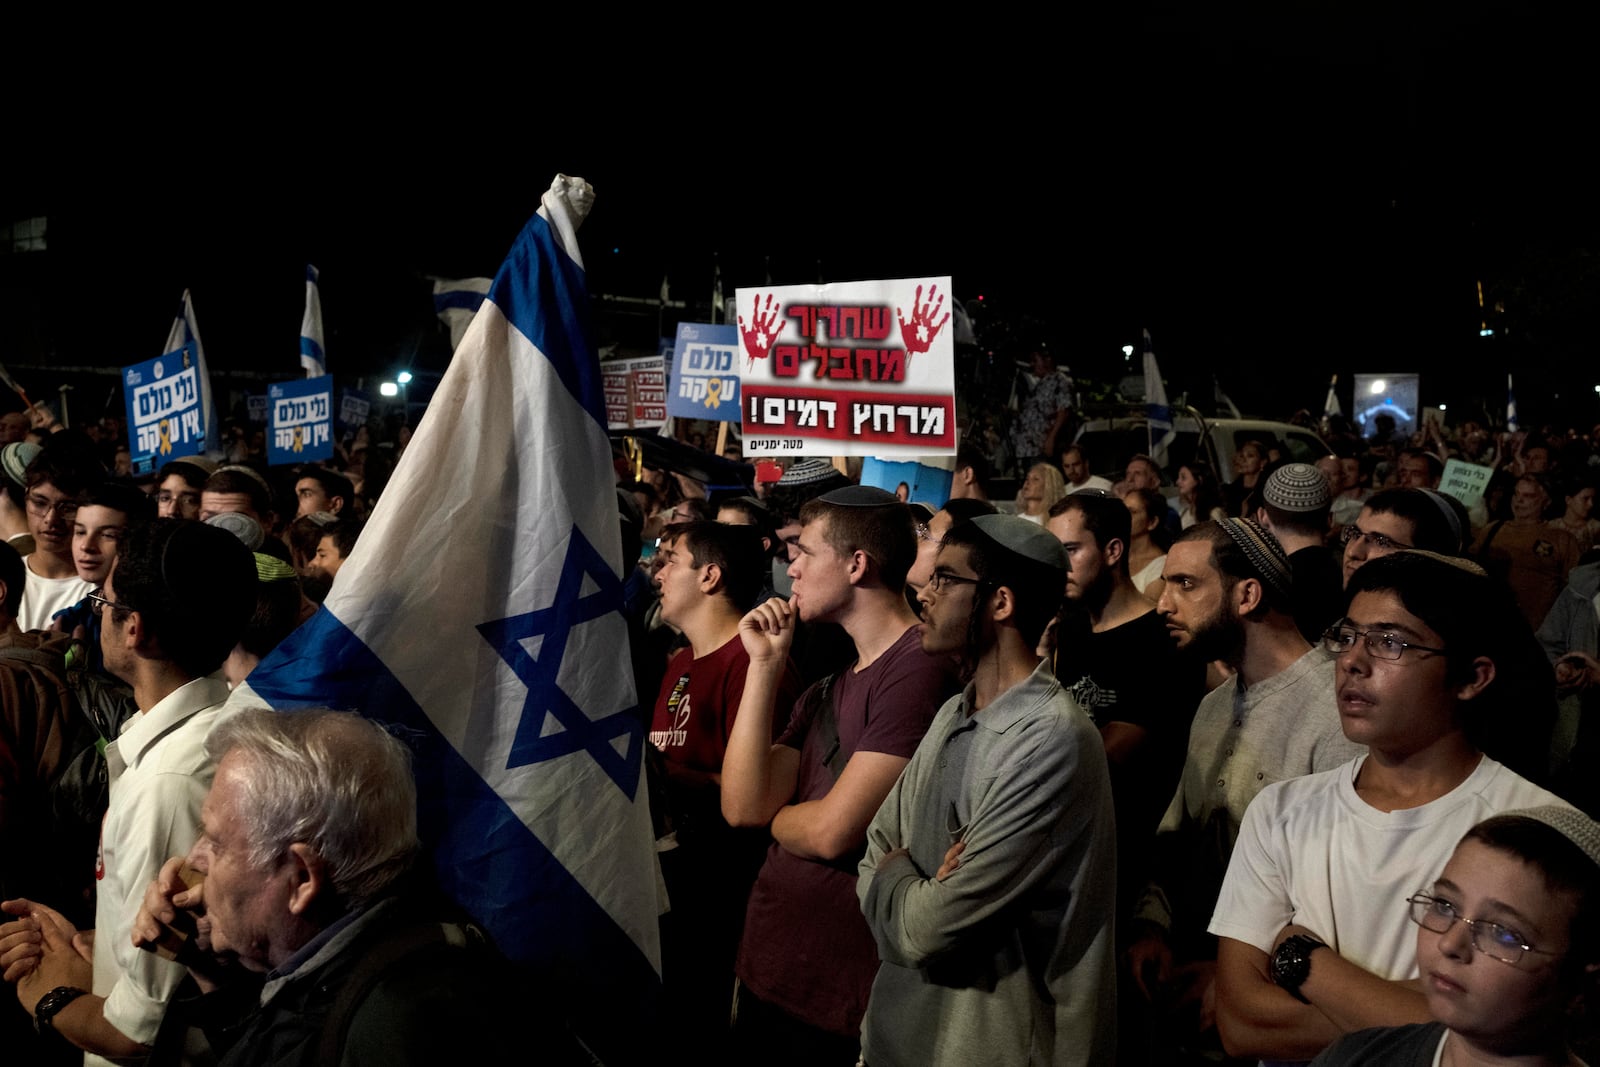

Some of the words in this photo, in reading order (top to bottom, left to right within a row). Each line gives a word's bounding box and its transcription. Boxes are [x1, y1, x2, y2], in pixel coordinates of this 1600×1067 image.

[787, 305, 891, 339] שחרור
[688, 346, 732, 371] כולם
[775, 343, 905, 381] מחבלים
[139, 387, 172, 417] כולם
[175, 374, 195, 404] בלי
[279, 401, 307, 422] כולם
[311, 397, 327, 417] בלי
[751, 397, 837, 428] דמים!
[853, 404, 945, 434] מרחץ
[182, 409, 200, 443] אין
[313, 422, 329, 447] אין
[750, 440, 780, 450] ימניים
[783, 440, 803, 449] מטה
